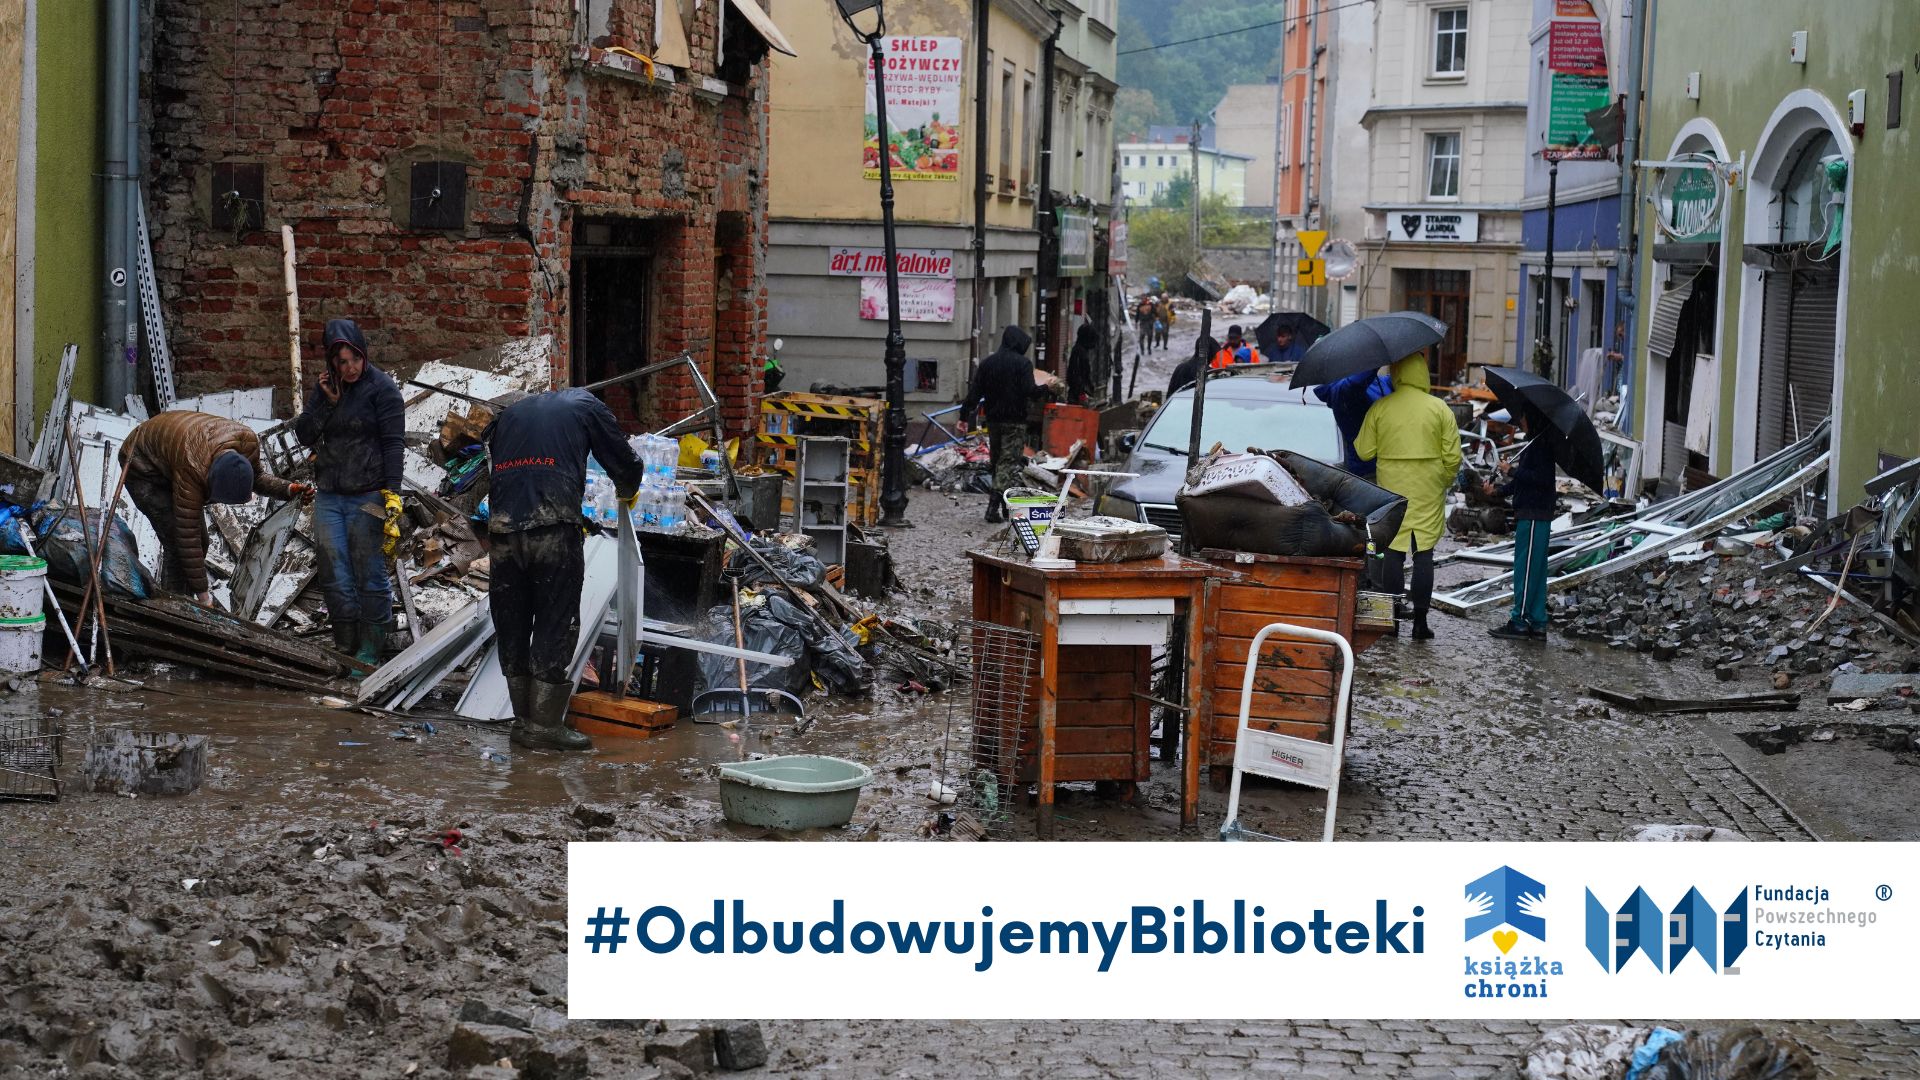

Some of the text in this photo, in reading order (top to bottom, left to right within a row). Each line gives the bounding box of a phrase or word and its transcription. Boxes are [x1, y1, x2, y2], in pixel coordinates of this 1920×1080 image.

[891, 39, 938, 52] SKLEP
[868, 73, 960, 83] WRZYWA-WĘDLINY
[885, 85, 941, 95] MIĘSO-RYBY
[901, 98, 930, 106] Matejki
[831, 251, 861, 273] art.
[495, 456, 555, 472] TAKAMAKA.FR
